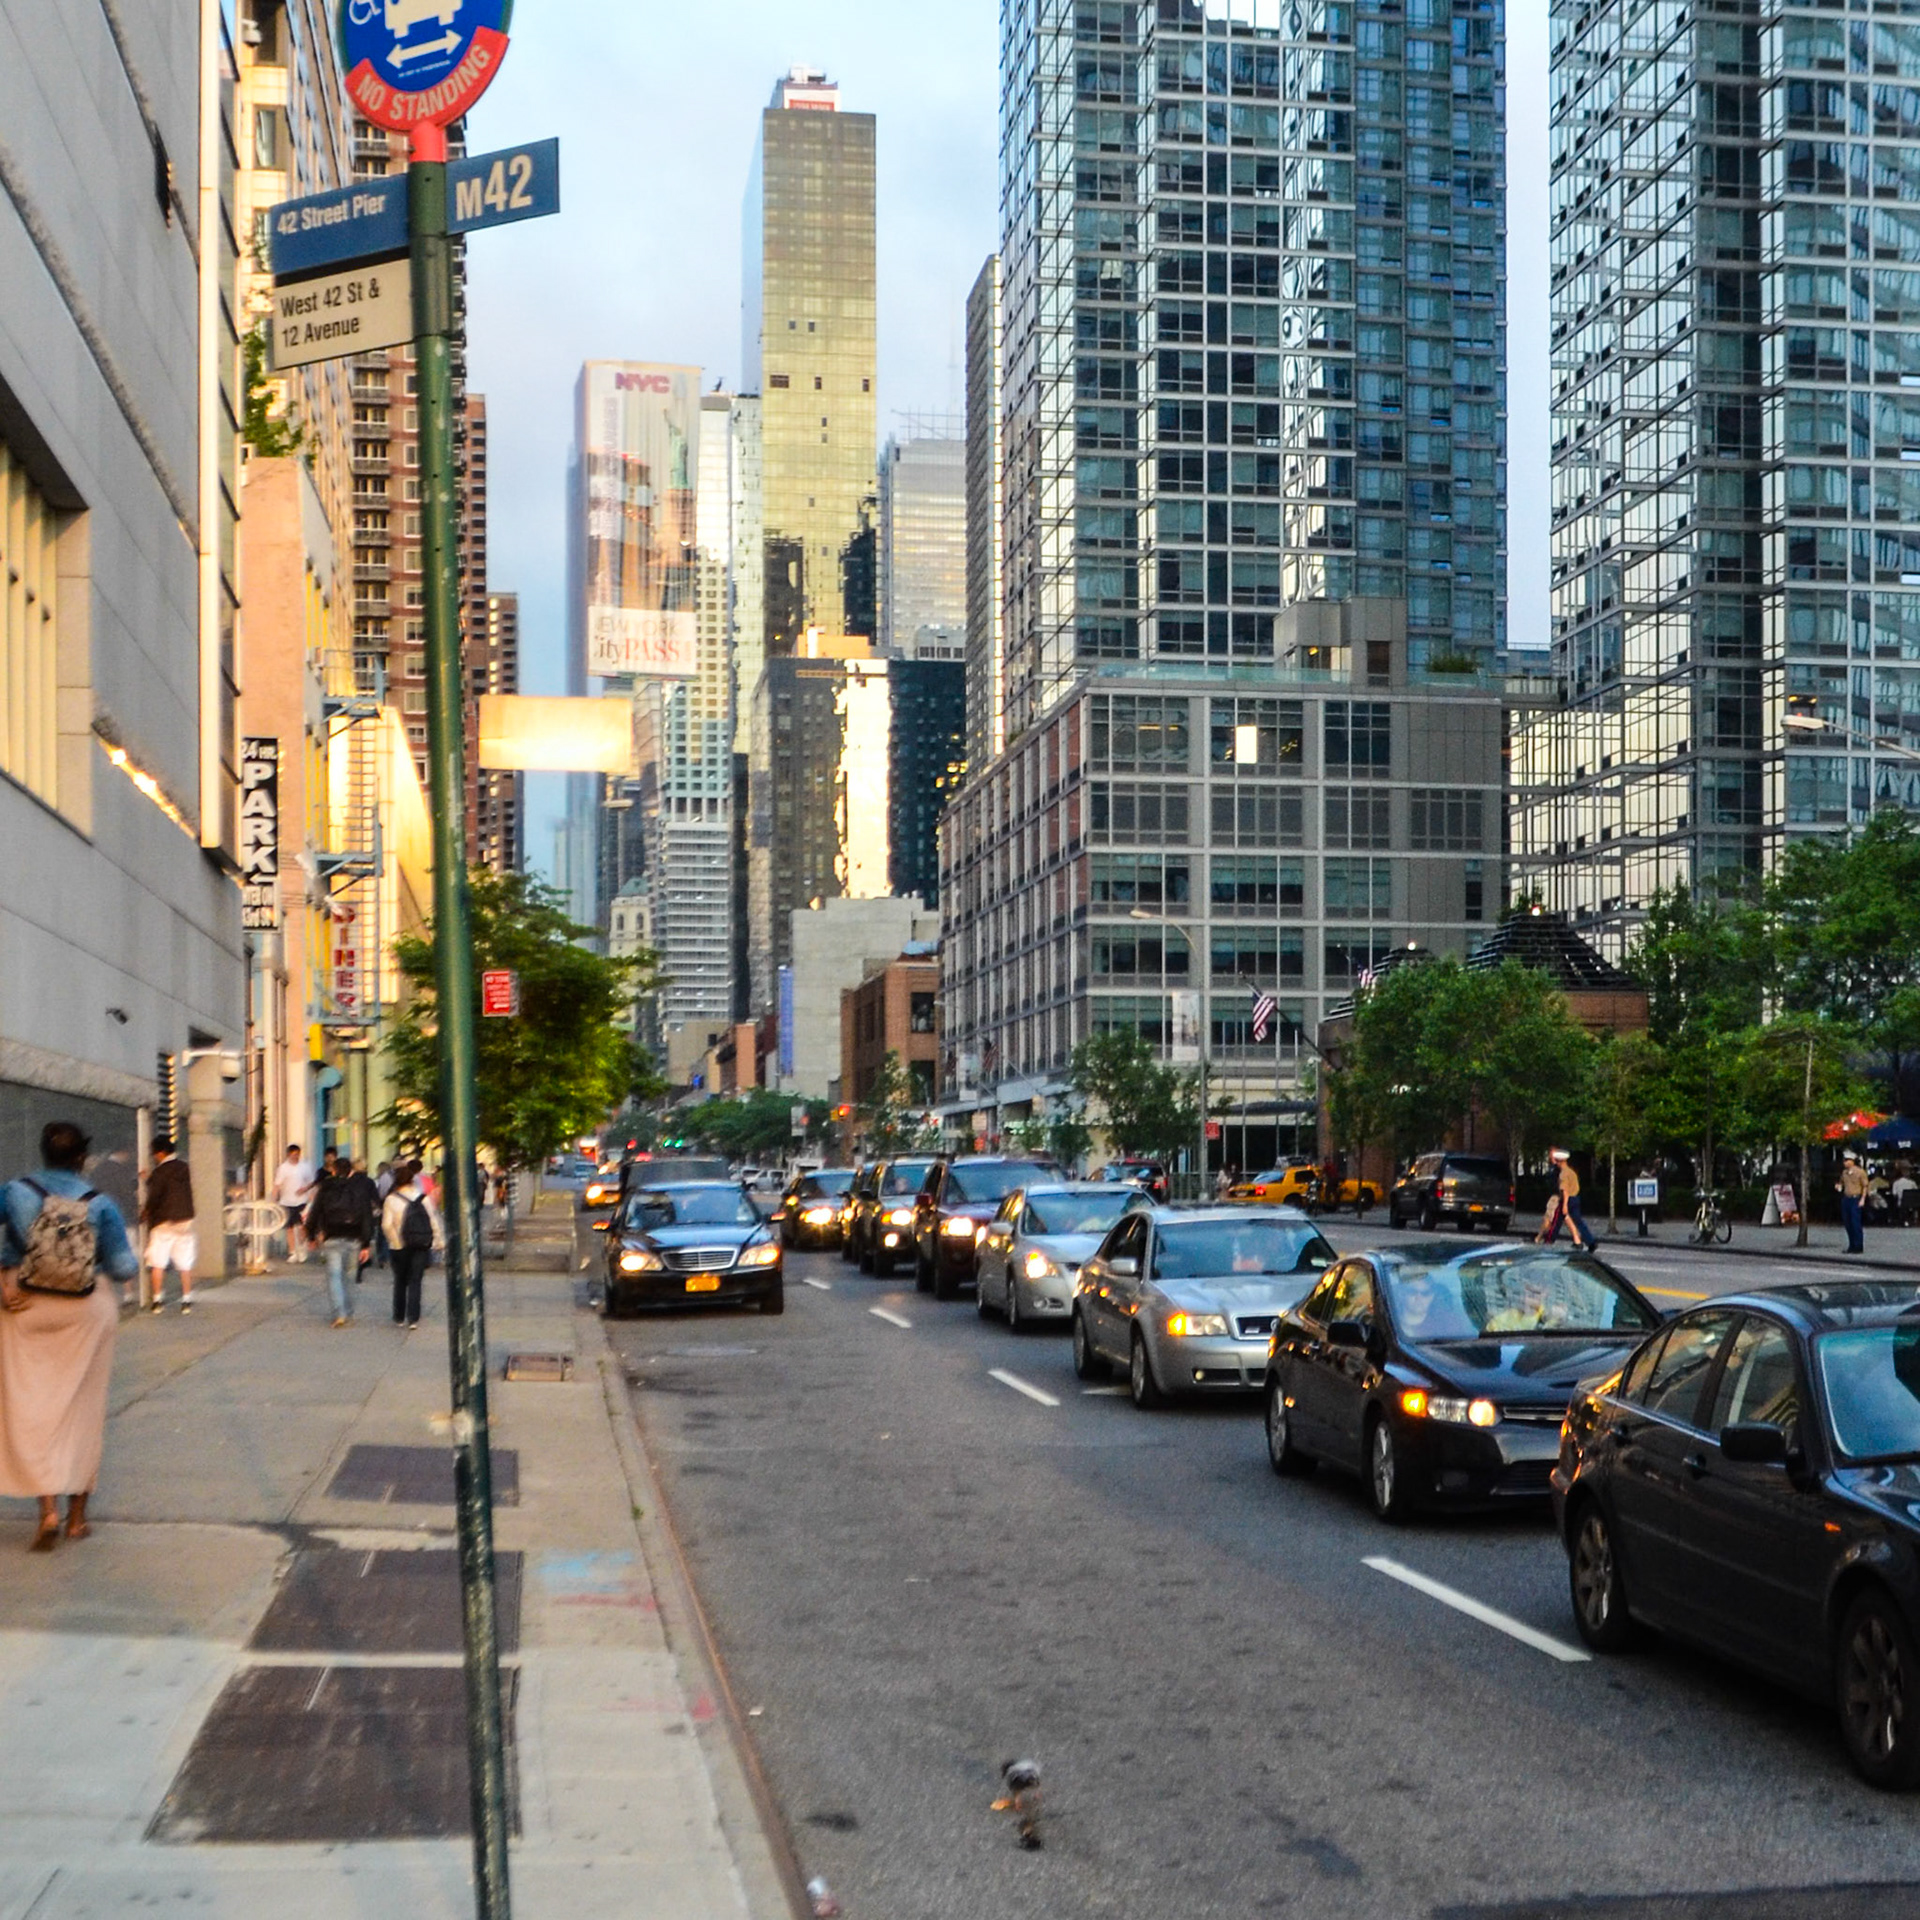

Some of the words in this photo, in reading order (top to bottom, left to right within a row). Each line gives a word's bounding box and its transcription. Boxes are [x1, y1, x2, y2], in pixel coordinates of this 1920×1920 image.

[355, 73, 387, 112] NO
[389, 45, 491, 121] STANDING
[455, 154, 534, 222] M42
[277, 210, 298, 236] 42
[301, 200, 349, 231] Street
[352, 193, 387, 220] Pier
[280, 292, 319, 319] West
[323, 285, 342, 309] 42
[346, 282, 363, 304] St
[368, 277, 381, 299] &
[282, 326, 300, 348] 12
[303, 316, 361, 344] Avenue
[615, 372, 671, 394] NYC
[242, 761, 277, 874] PARK
